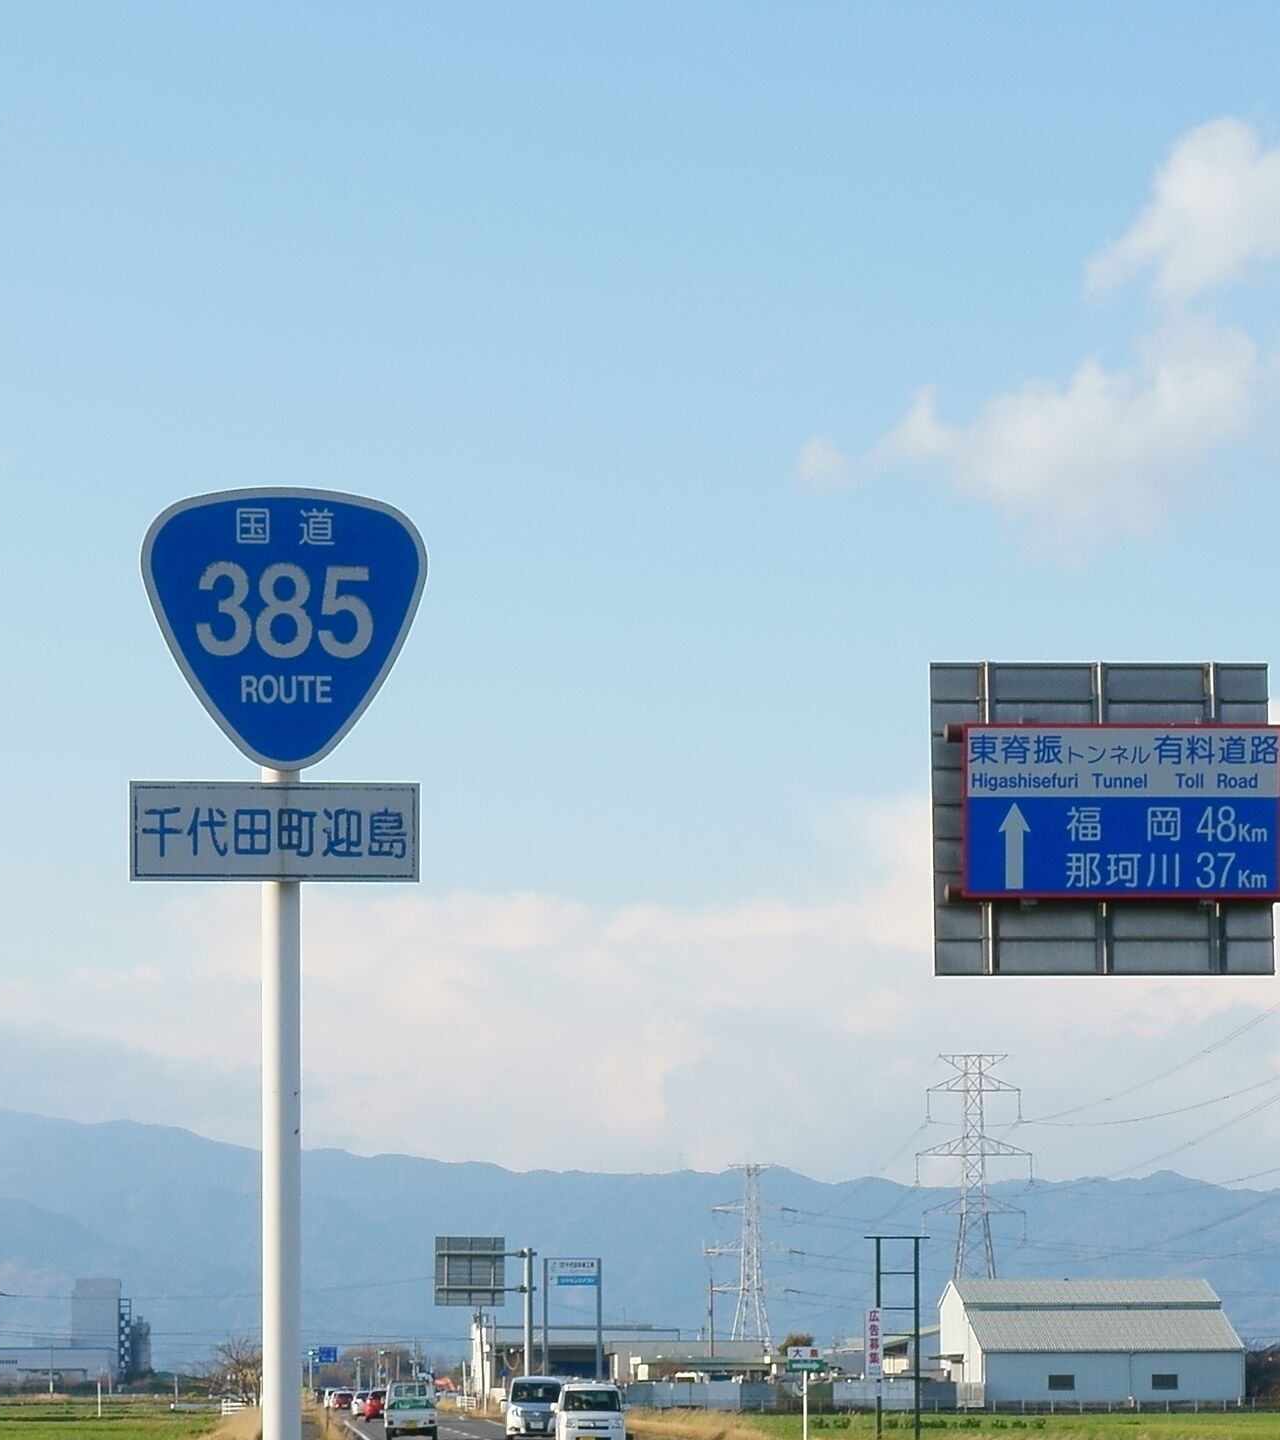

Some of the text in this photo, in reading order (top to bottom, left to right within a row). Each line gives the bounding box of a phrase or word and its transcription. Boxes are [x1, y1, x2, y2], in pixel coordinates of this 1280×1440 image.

[236, 508, 335, 545] 国道
[196, 561, 374, 659] 385
[241, 675, 332, 703] ROUTE
[971, 772, 1258, 792] Higashisefuri Tunnel Toll Road
[142, 807, 407, 859] 千代田町迎島
[1066, 806, 1181, 842] 福岡
[1066, 852, 1180, 888] 那珂川
